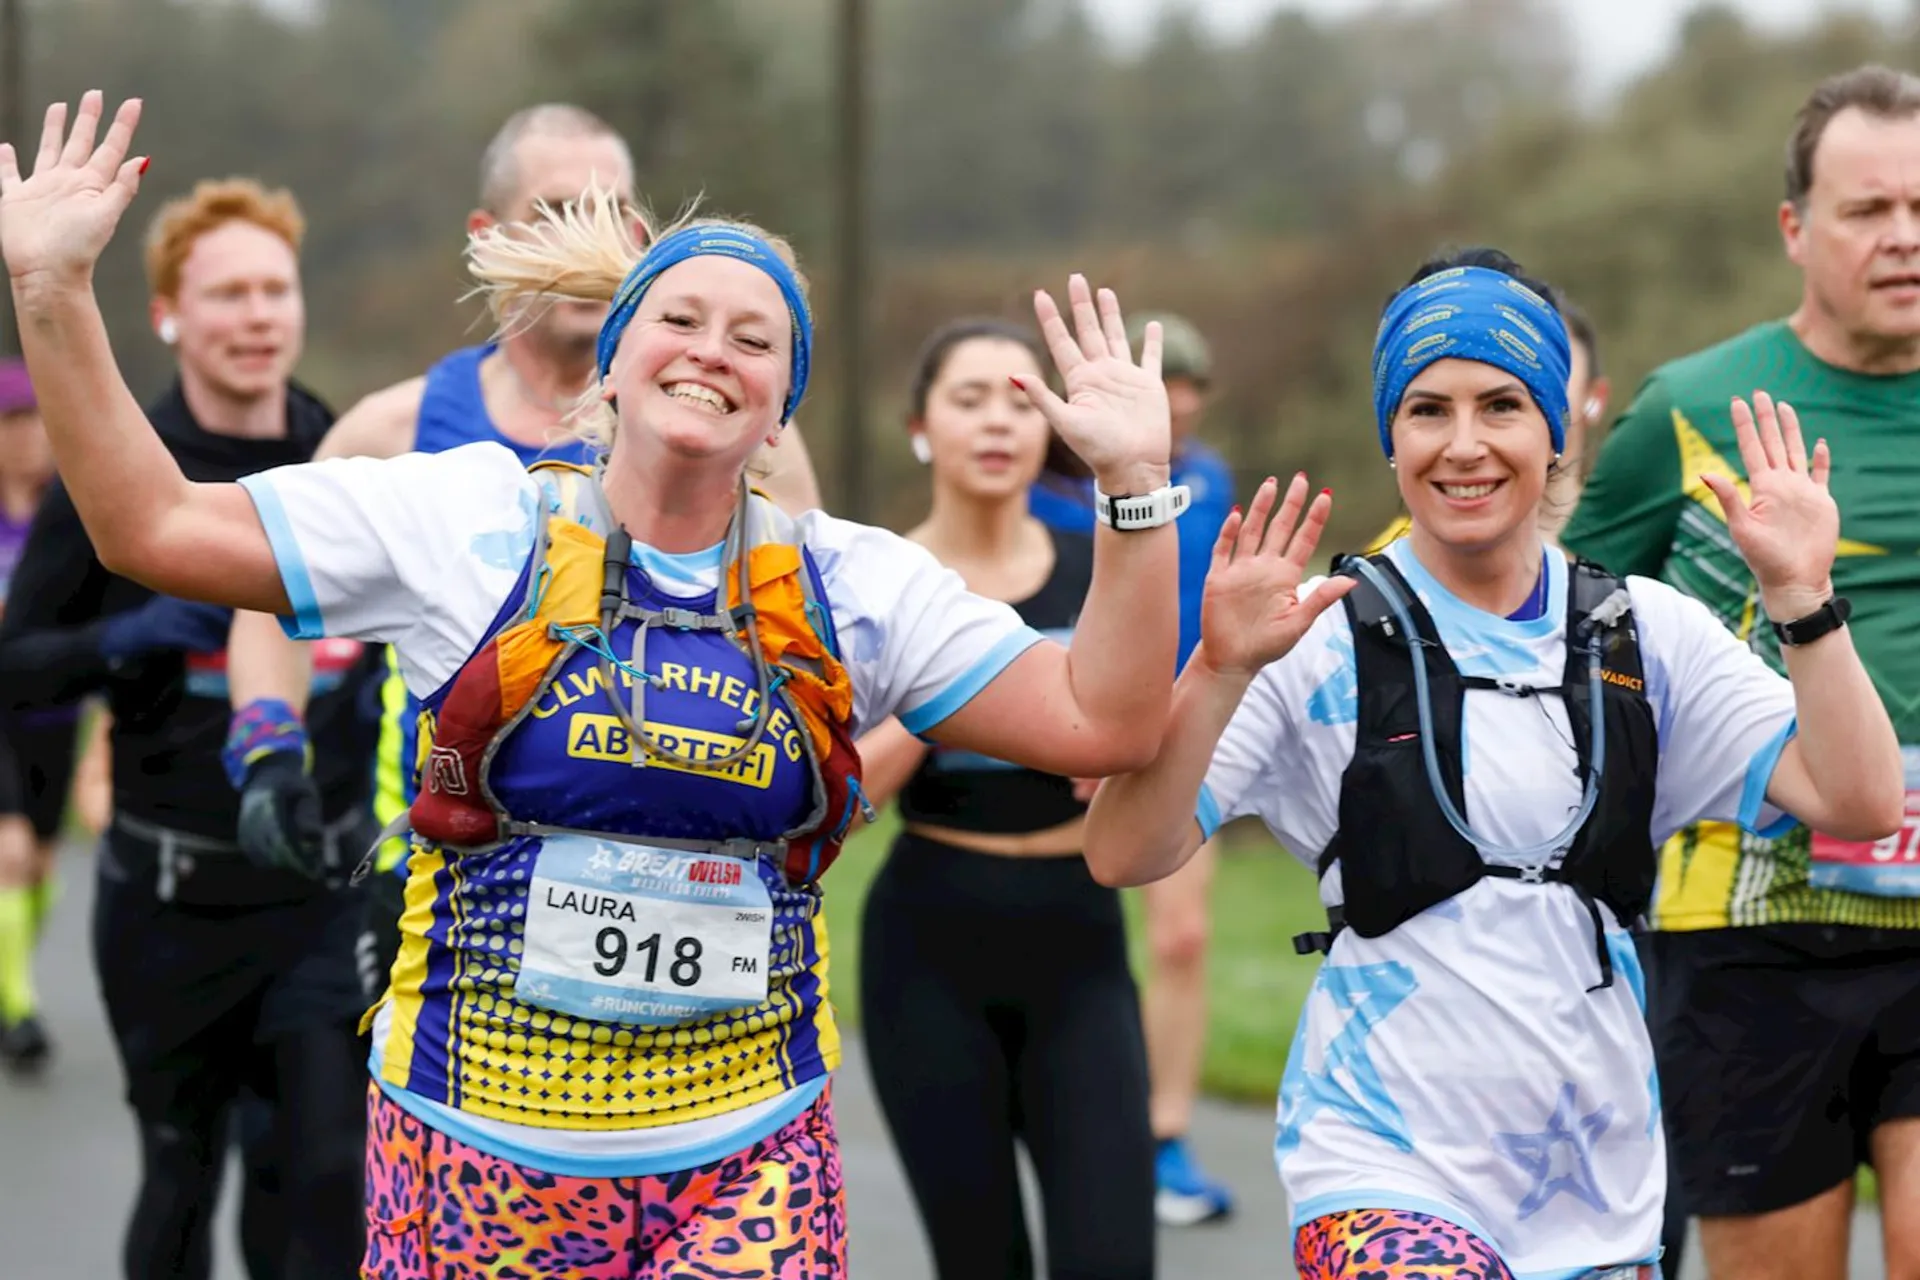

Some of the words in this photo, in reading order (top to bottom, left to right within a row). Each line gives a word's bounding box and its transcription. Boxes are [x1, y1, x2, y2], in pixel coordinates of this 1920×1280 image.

[1592, 669, 1643, 691] VADICT
[574, 723, 766, 781] ABRTEFI
[688, 860, 742, 885] WELSH
[546, 887, 637, 922] LAURA
[593, 926, 703, 987] 918
[732, 956, 757, 973] FM
